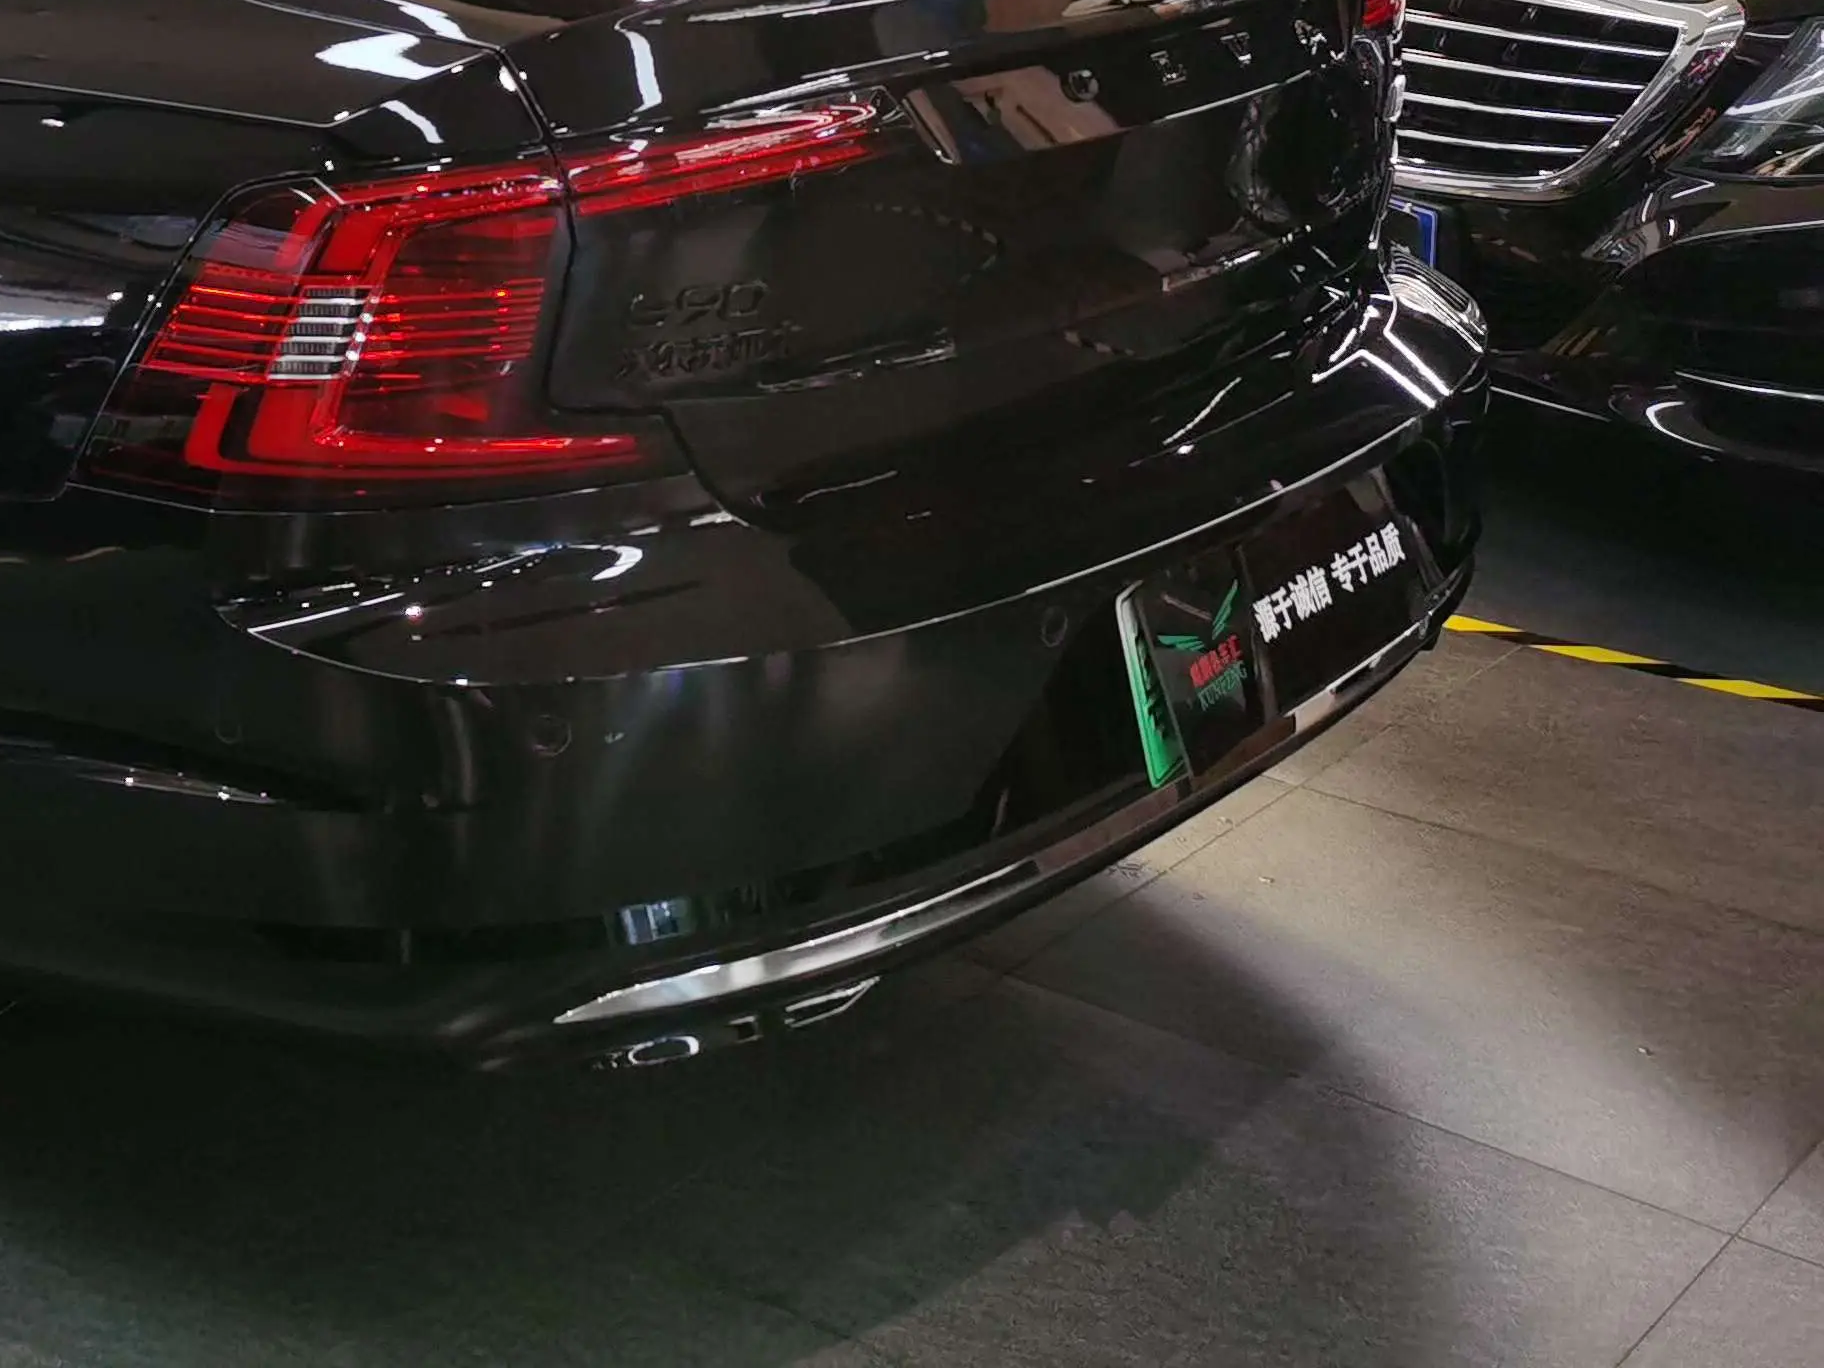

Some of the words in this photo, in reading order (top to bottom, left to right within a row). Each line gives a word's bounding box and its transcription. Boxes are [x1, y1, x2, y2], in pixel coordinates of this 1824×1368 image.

[1253, 565, 1333, 643] 源于诚信
[1330, 521, 1406, 593] 专于品质
